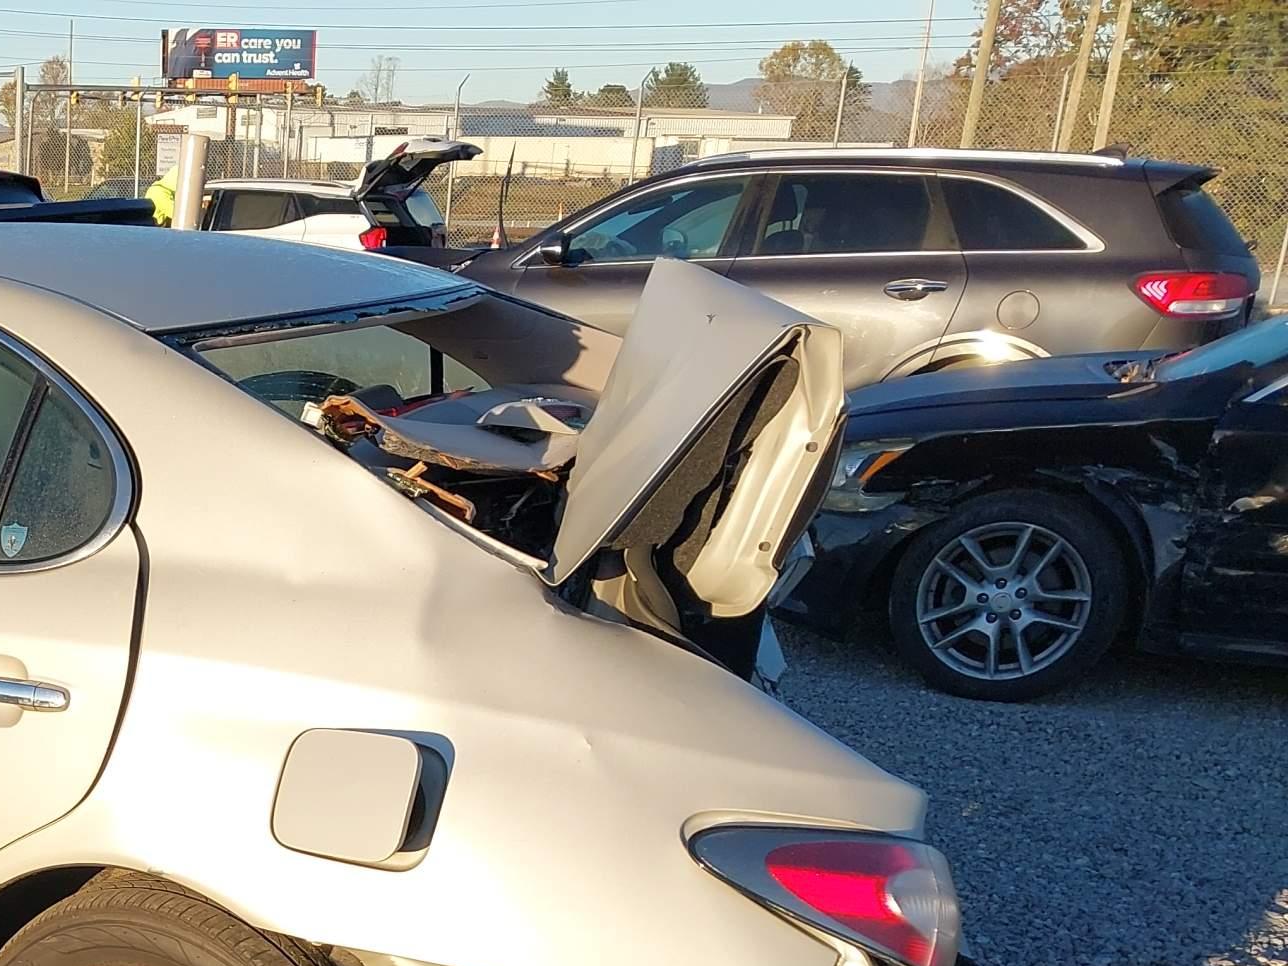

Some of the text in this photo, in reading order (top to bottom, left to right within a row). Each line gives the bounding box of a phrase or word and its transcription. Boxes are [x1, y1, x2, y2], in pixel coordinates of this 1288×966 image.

[216, 32, 302, 52] ER care you
[215, 51, 278, 63] can trust.
